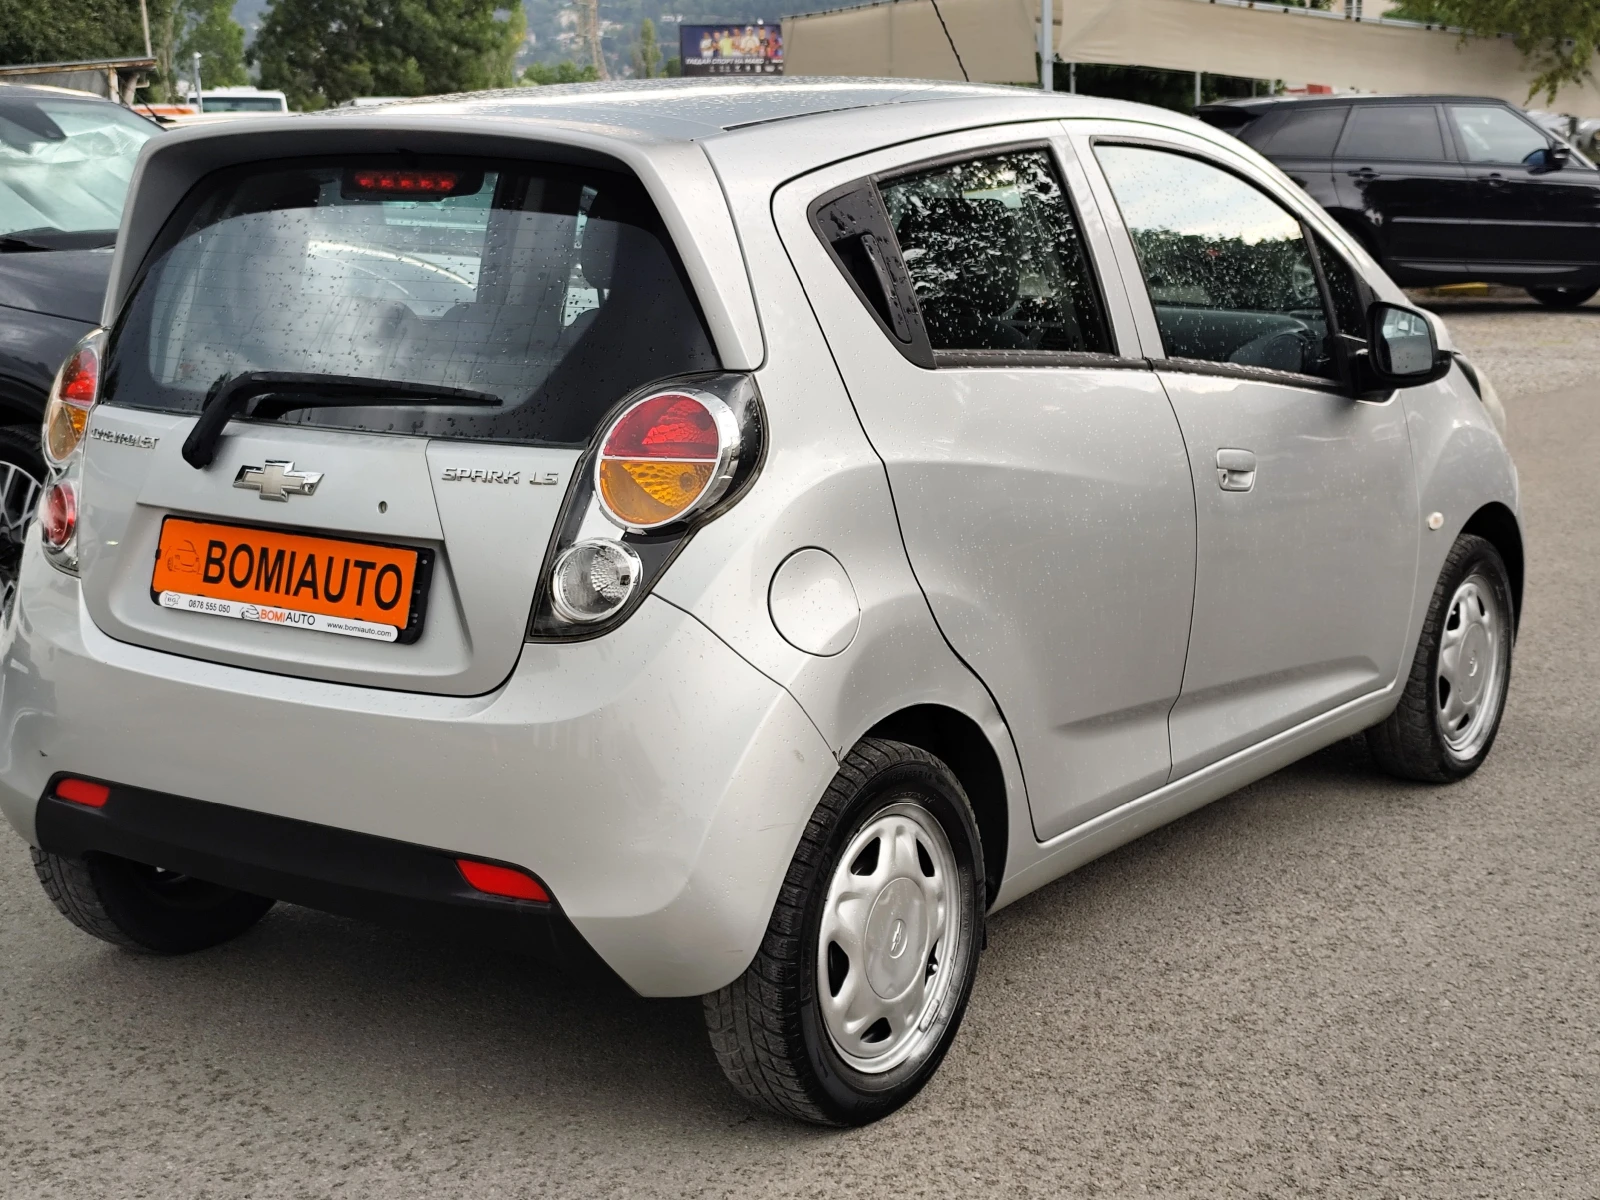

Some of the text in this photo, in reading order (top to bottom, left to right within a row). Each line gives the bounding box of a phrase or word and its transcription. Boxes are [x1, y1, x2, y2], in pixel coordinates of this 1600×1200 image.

[90, 428, 160, 449] CHEVROLET
[441, 467, 559, 486] SPARK LS
[202, 539, 403, 611] BOMIAUTO
[188, 600, 230, 613] 0878 555 050
[260, 609, 316, 625] BOMIAUTO
[327, 621, 392, 637] www.bomiauto.com
